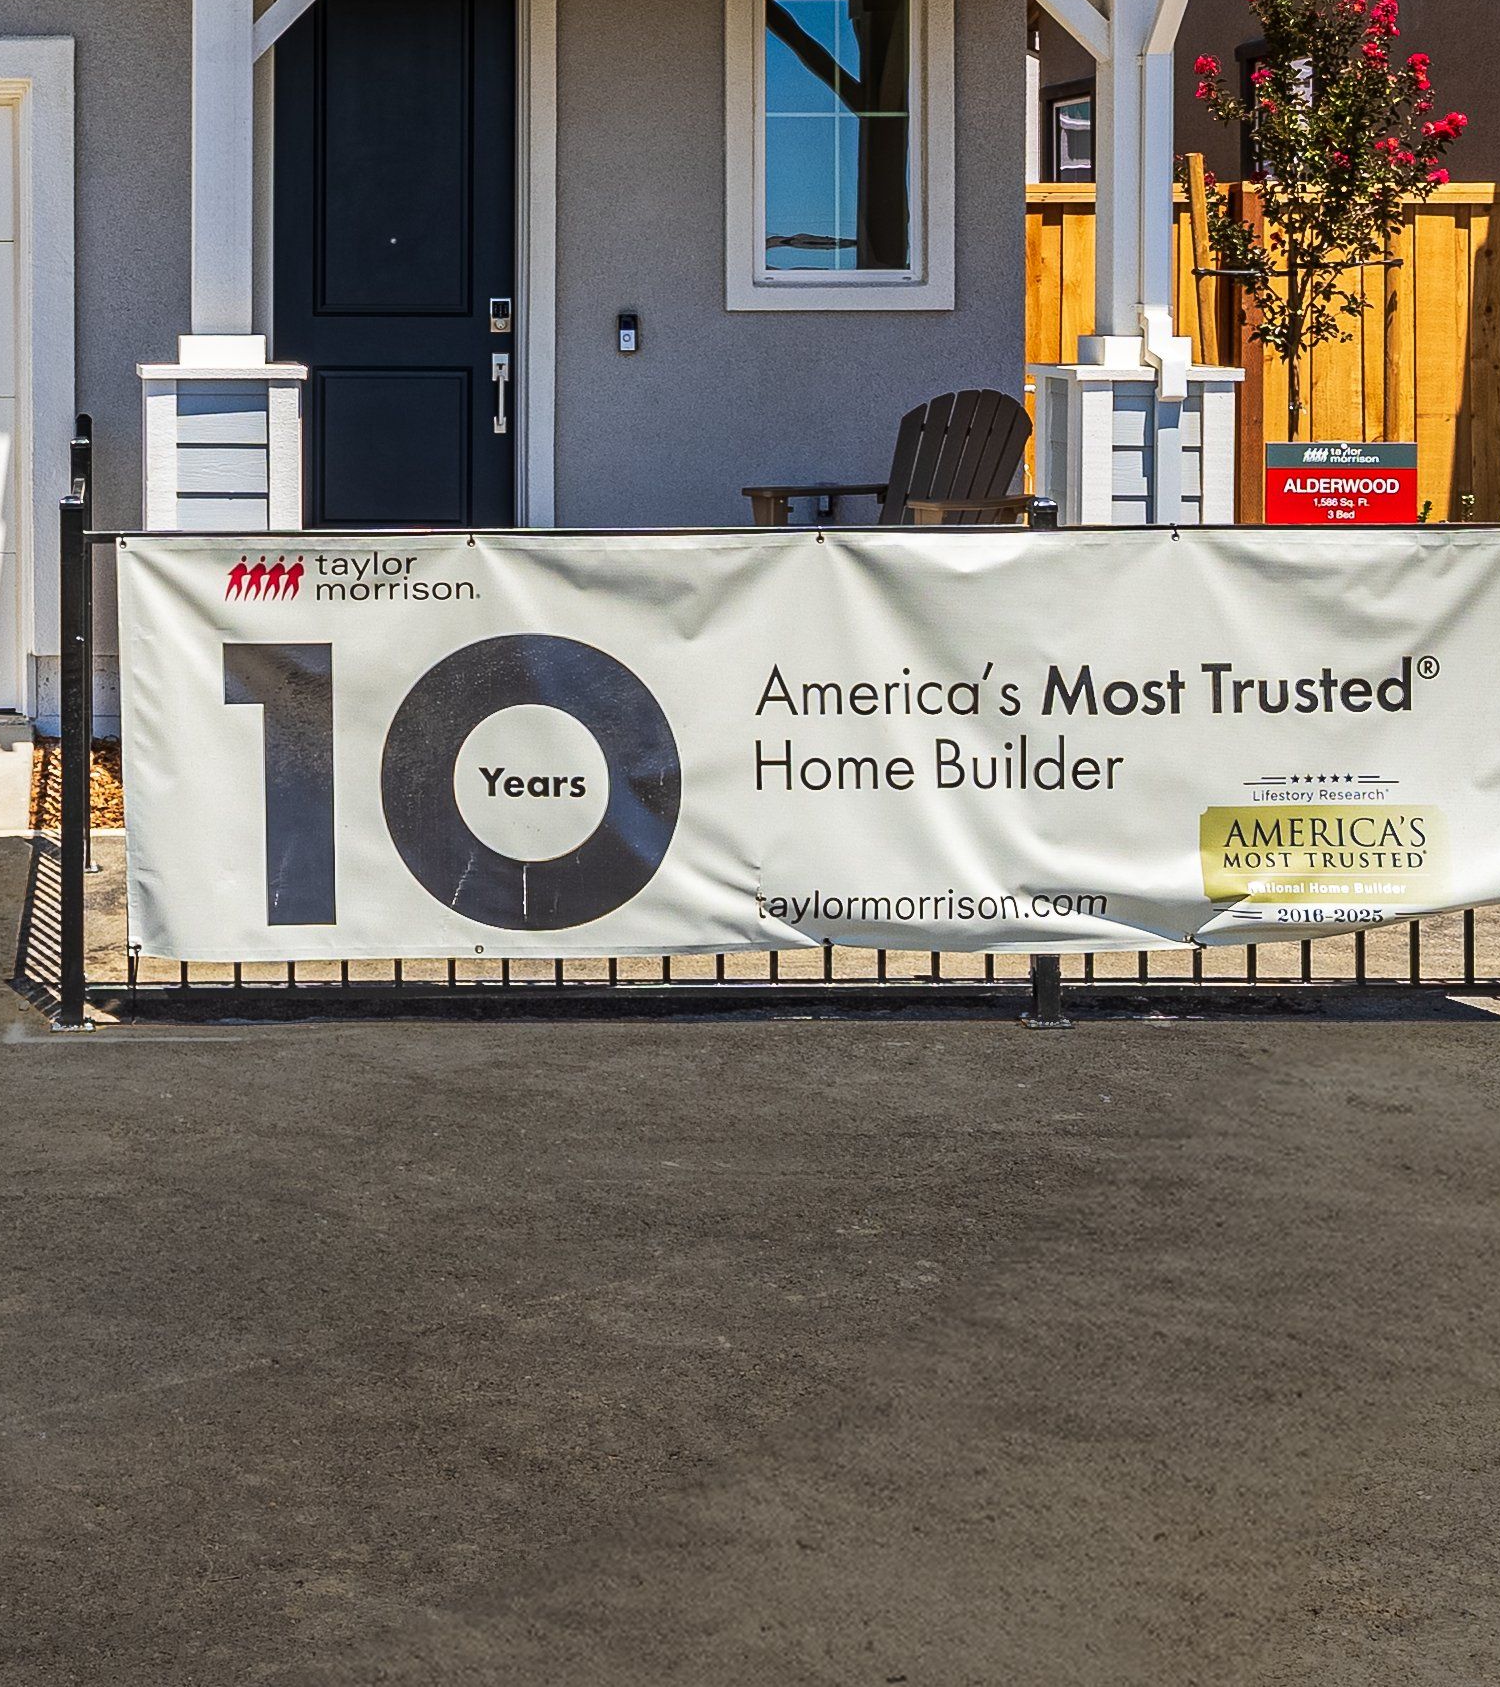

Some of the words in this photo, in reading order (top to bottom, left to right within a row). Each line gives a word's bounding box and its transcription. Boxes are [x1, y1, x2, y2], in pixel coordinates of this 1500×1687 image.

[1330, 455, 1379, 463] morrison
[1283, 478, 1400, 494] ALDERWOOD
[1313, 498, 1338, 507] 1,586
[1340, 498, 1355, 508] Sq.
[1327, 510, 1334, 519] 3
[1336, 510, 1355, 519] Bed
[315, 551, 418, 581] taylor
[755, 662, 1021, 716] America's
[1041, 665, 1186, 717] Most
[755, 739, 916, 791] Home
[935, 735, 1124, 791] Builder
[222, 633, 682, 931] 10
[478, 767, 587, 799] Years
[1252, 789, 1314, 803] Lifestory
[1223, 816, 1427, 848] AMERICA'S
[1223, 852, 1292, 869] MOST
[1248, 882, 1305, 894] National
[1309, 882, 1350, 894] Home
[1354, 882, 1407, 894] Builder
[756, 889, 1108, 924] taylormorrison.com
[1277, 909, 1384, 923] 2016-2025
